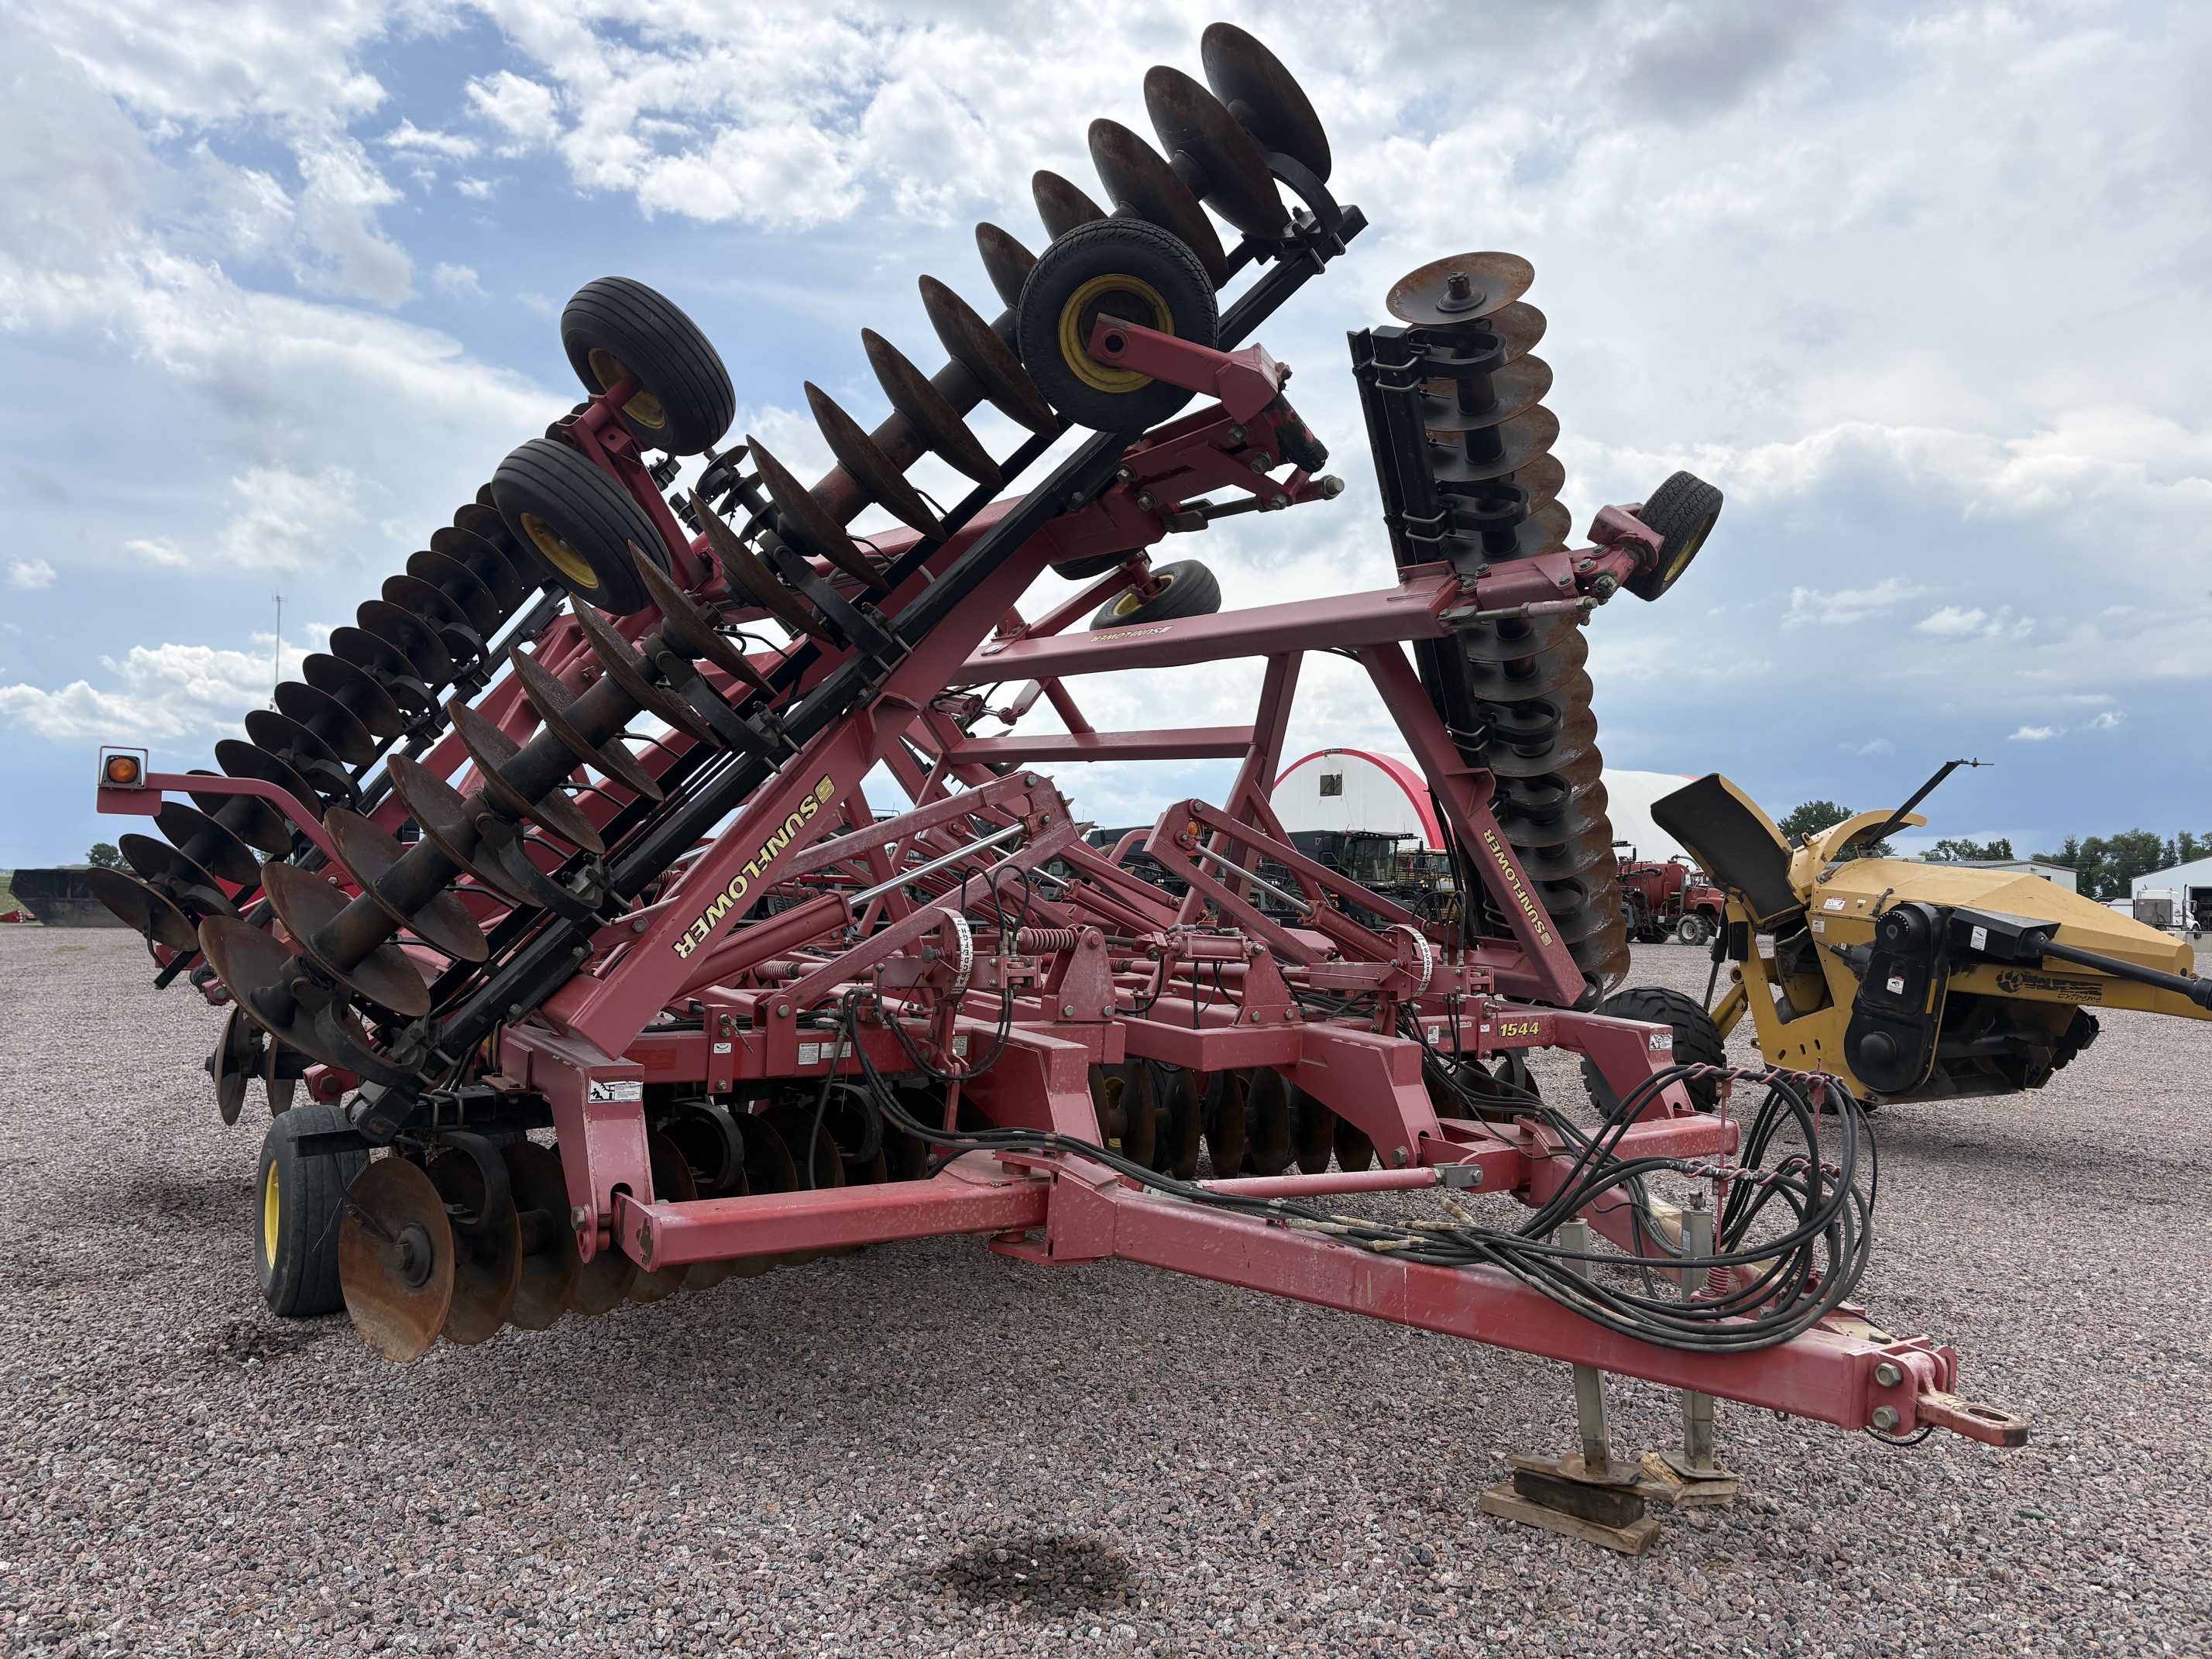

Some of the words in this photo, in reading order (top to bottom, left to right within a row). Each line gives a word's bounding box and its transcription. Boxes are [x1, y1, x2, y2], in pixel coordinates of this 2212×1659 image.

[1090, 627, 1163, 642] SUNFLOWER
[672, 795, 819, 960] SUNFLOWER
[1482, 828, 1546, 939] SUNFLOWER
[1499, 1022, 1540, 1038] 1544
